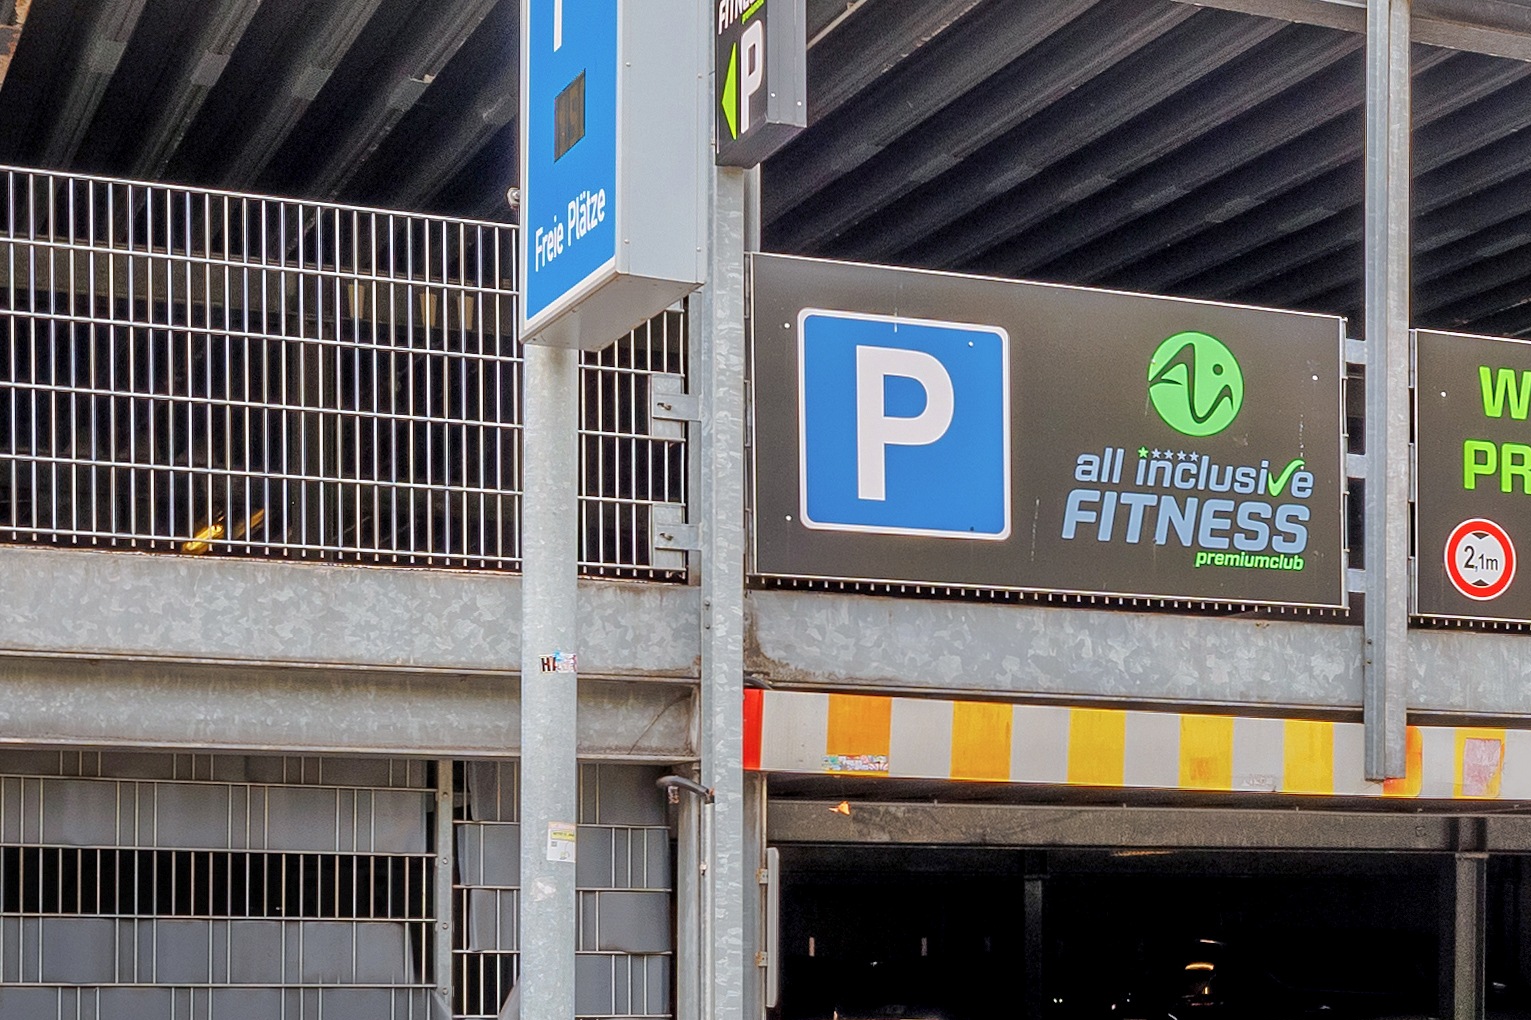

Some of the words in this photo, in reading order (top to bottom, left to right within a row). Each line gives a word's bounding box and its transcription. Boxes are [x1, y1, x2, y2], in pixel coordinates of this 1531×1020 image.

[740, 19, 763, 134] P
[535, 214, 564, 272] Freie
[567, 188, 606, 247] Plätze
[856, 345, 955, 501] P
[1074, 446, 1124, 485] all
[1061, 488, 1311, 554] FITNESS
[1195, 550, 1305, 571] premiumclub
